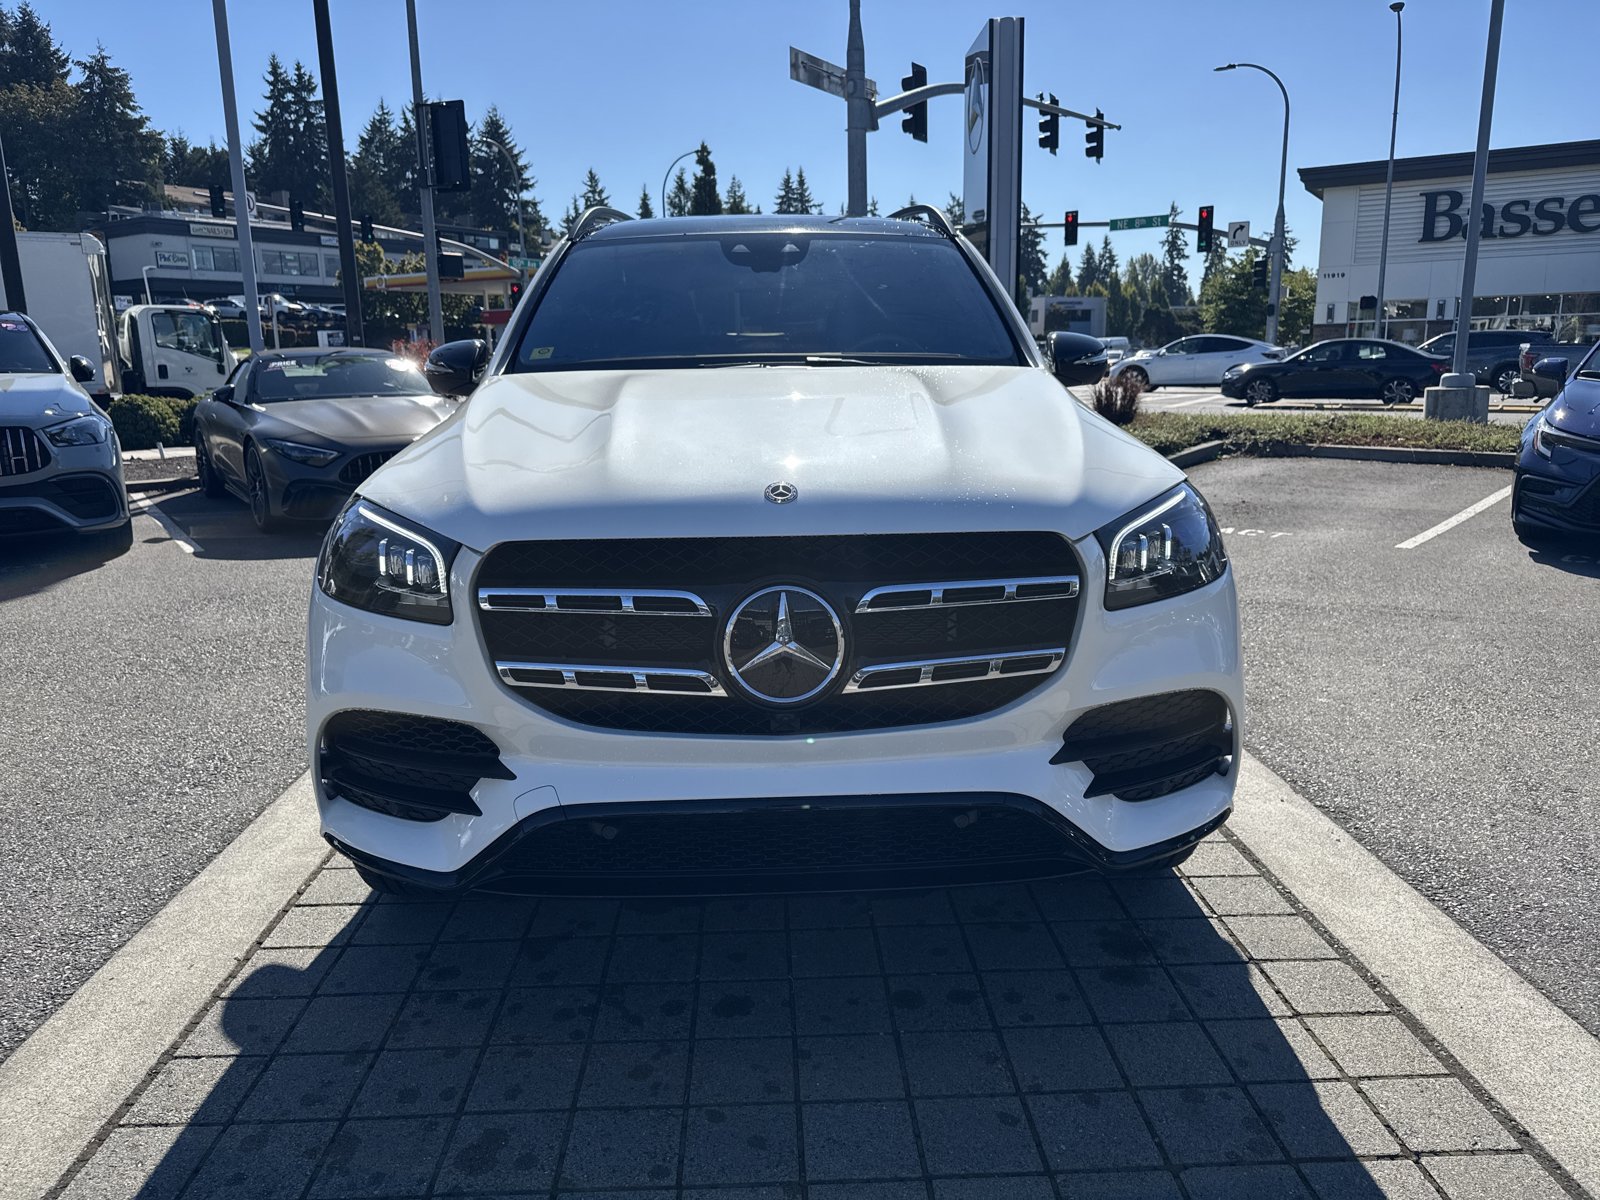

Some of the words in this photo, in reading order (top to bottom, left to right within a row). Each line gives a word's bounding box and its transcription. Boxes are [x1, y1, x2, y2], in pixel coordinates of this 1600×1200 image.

[1117, 219, 1128, 229] NE
[1134, 217, 1146, 228] 8th
[1152, 216, 1161, 227] St
